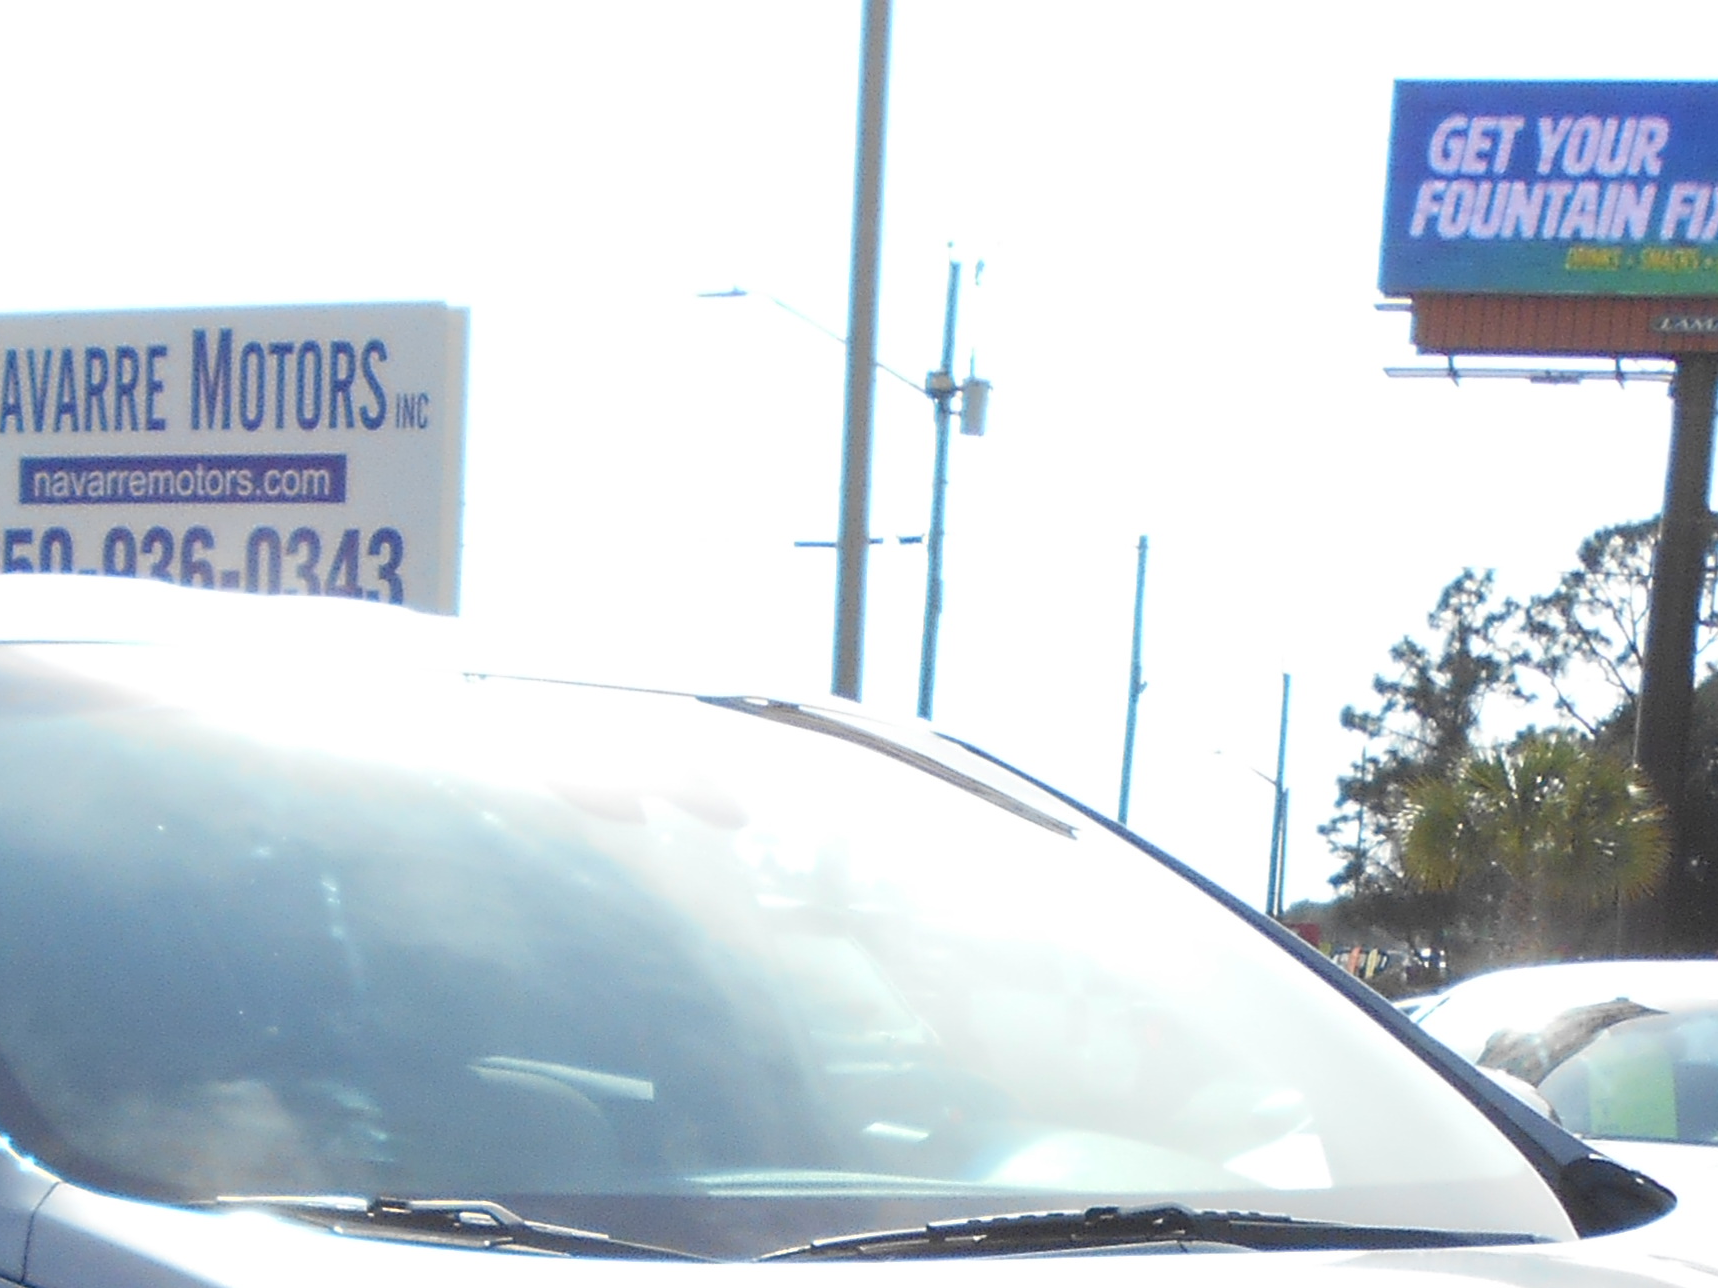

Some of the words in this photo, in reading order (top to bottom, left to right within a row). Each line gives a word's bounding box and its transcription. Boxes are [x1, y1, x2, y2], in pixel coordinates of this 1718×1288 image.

[1427, 114, 1525, 175] GET
[1536, 114, 1670, 177] YOUR
[1409, 178, 1658, 240] FOUNTAIN
[190, 327, 389, 432] MOTORS
[395, 391, 430, 430] INC
[32, 464, 331, 498] navarremotors.com
